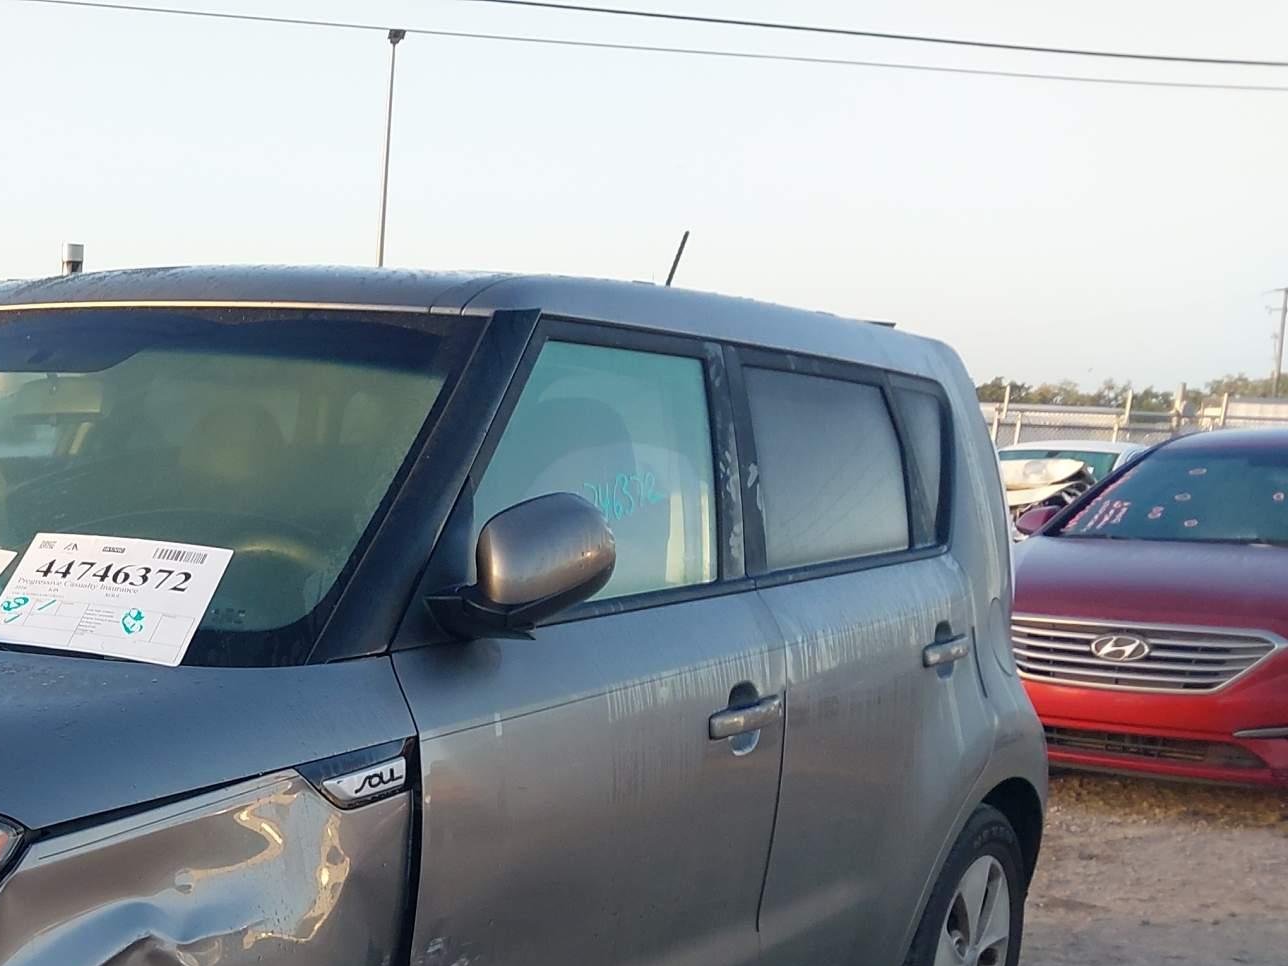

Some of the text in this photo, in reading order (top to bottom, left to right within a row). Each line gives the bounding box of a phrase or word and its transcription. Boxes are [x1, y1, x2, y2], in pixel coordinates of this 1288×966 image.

[17, 577, 139, 594] Progressive Casualty Insurance
[35, 558, 192, 593] 44746372
[354, 767, 404, 794] SOUL
